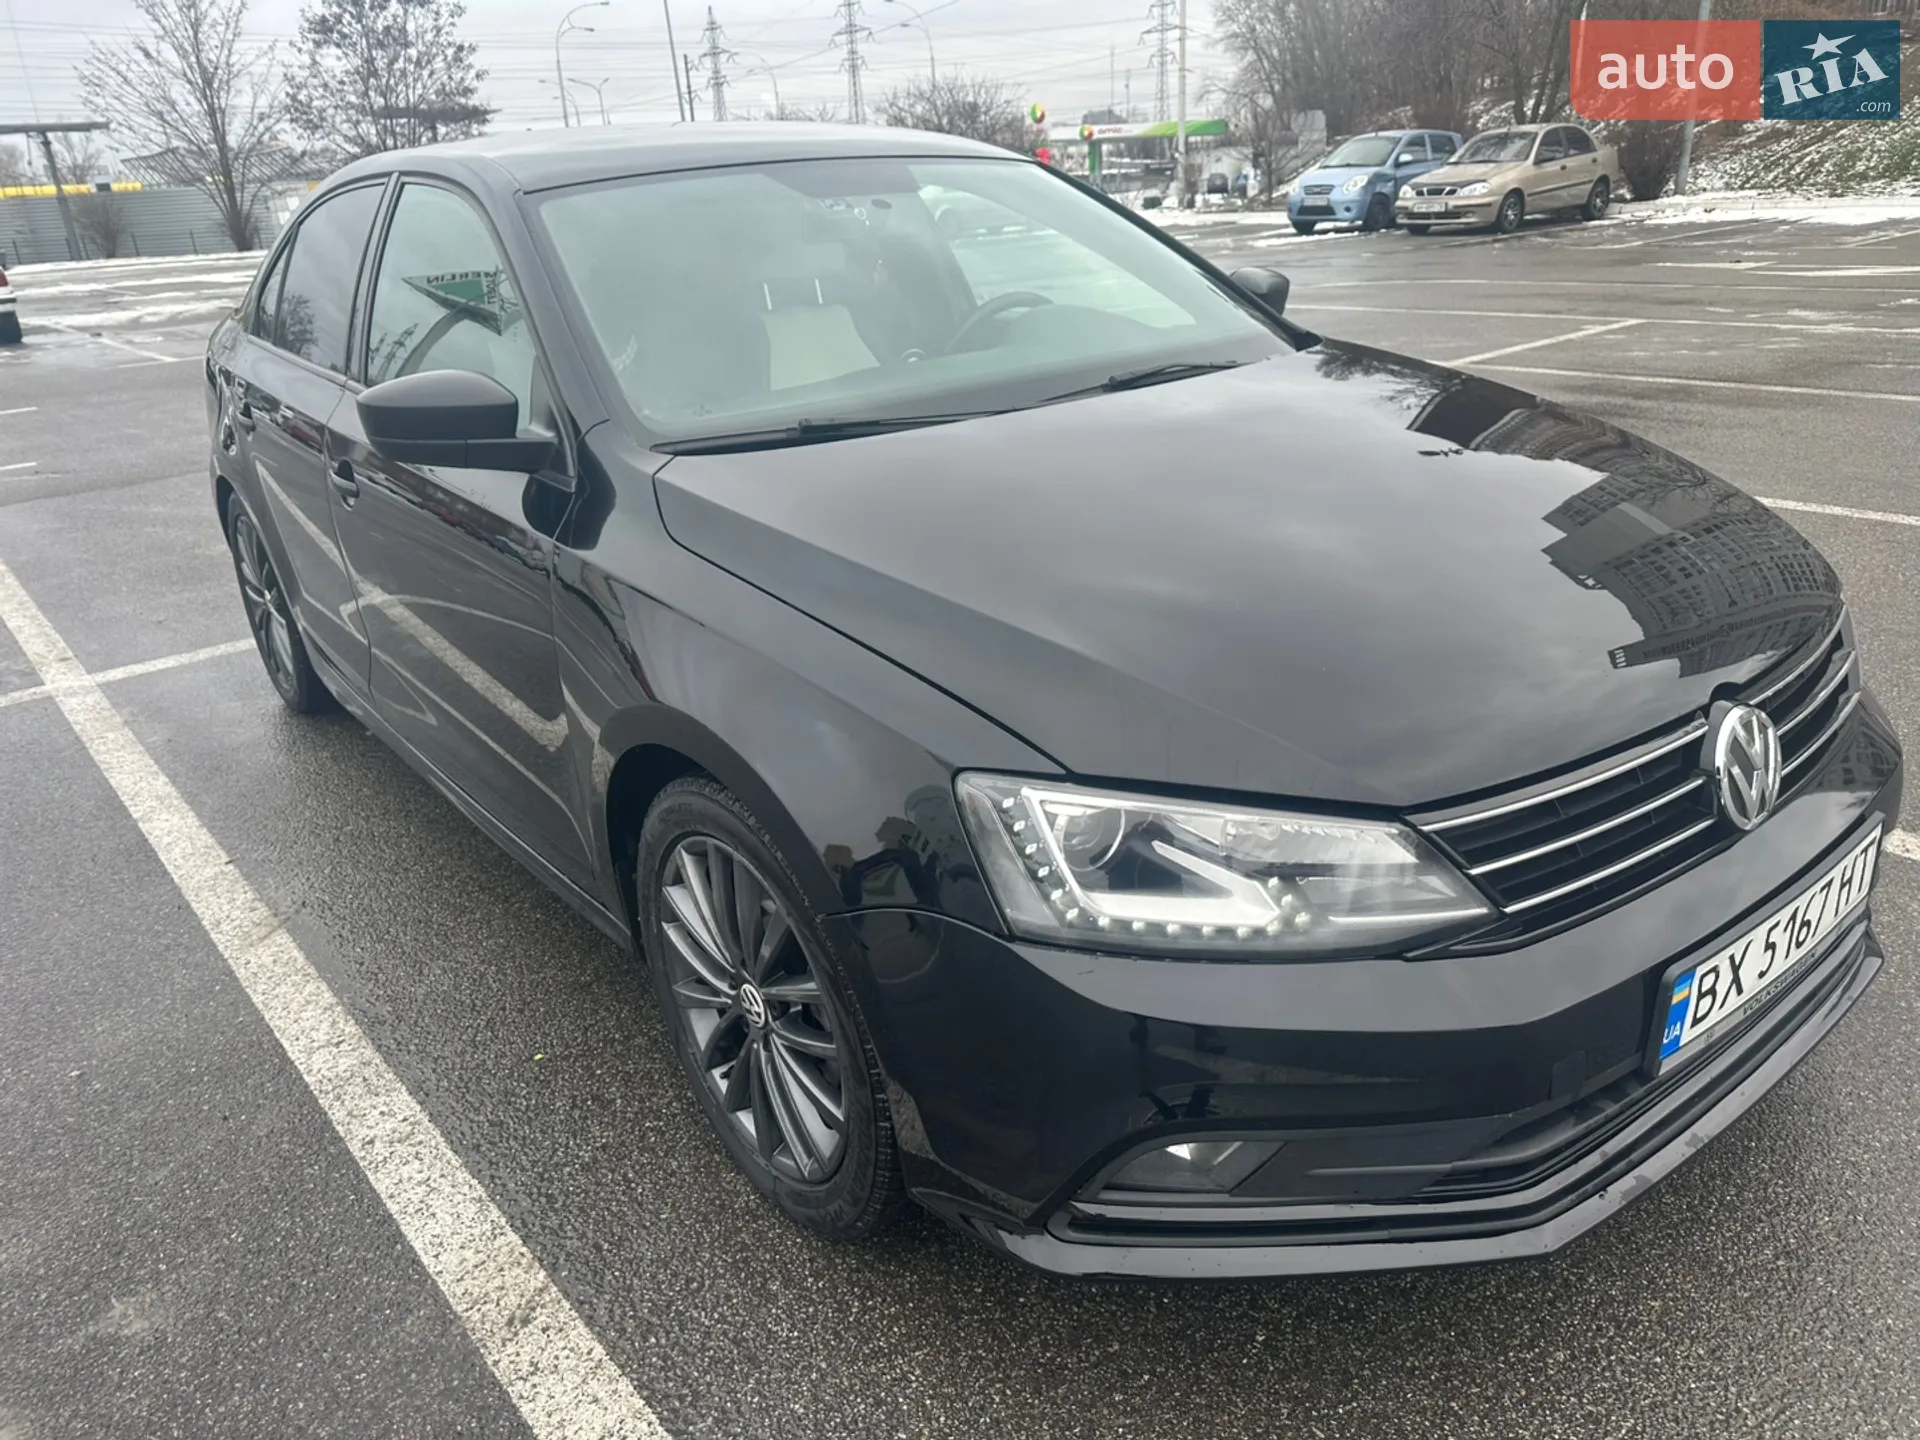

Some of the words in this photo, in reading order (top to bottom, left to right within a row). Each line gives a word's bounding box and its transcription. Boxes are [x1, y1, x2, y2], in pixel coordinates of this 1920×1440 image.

[1690, 939, 1754, 1029] BX
[1757, 877, 1835, 980] 5167
[1834, 835, 1878, 918] HT
[1662, 1021, 1681, 1044] UA
